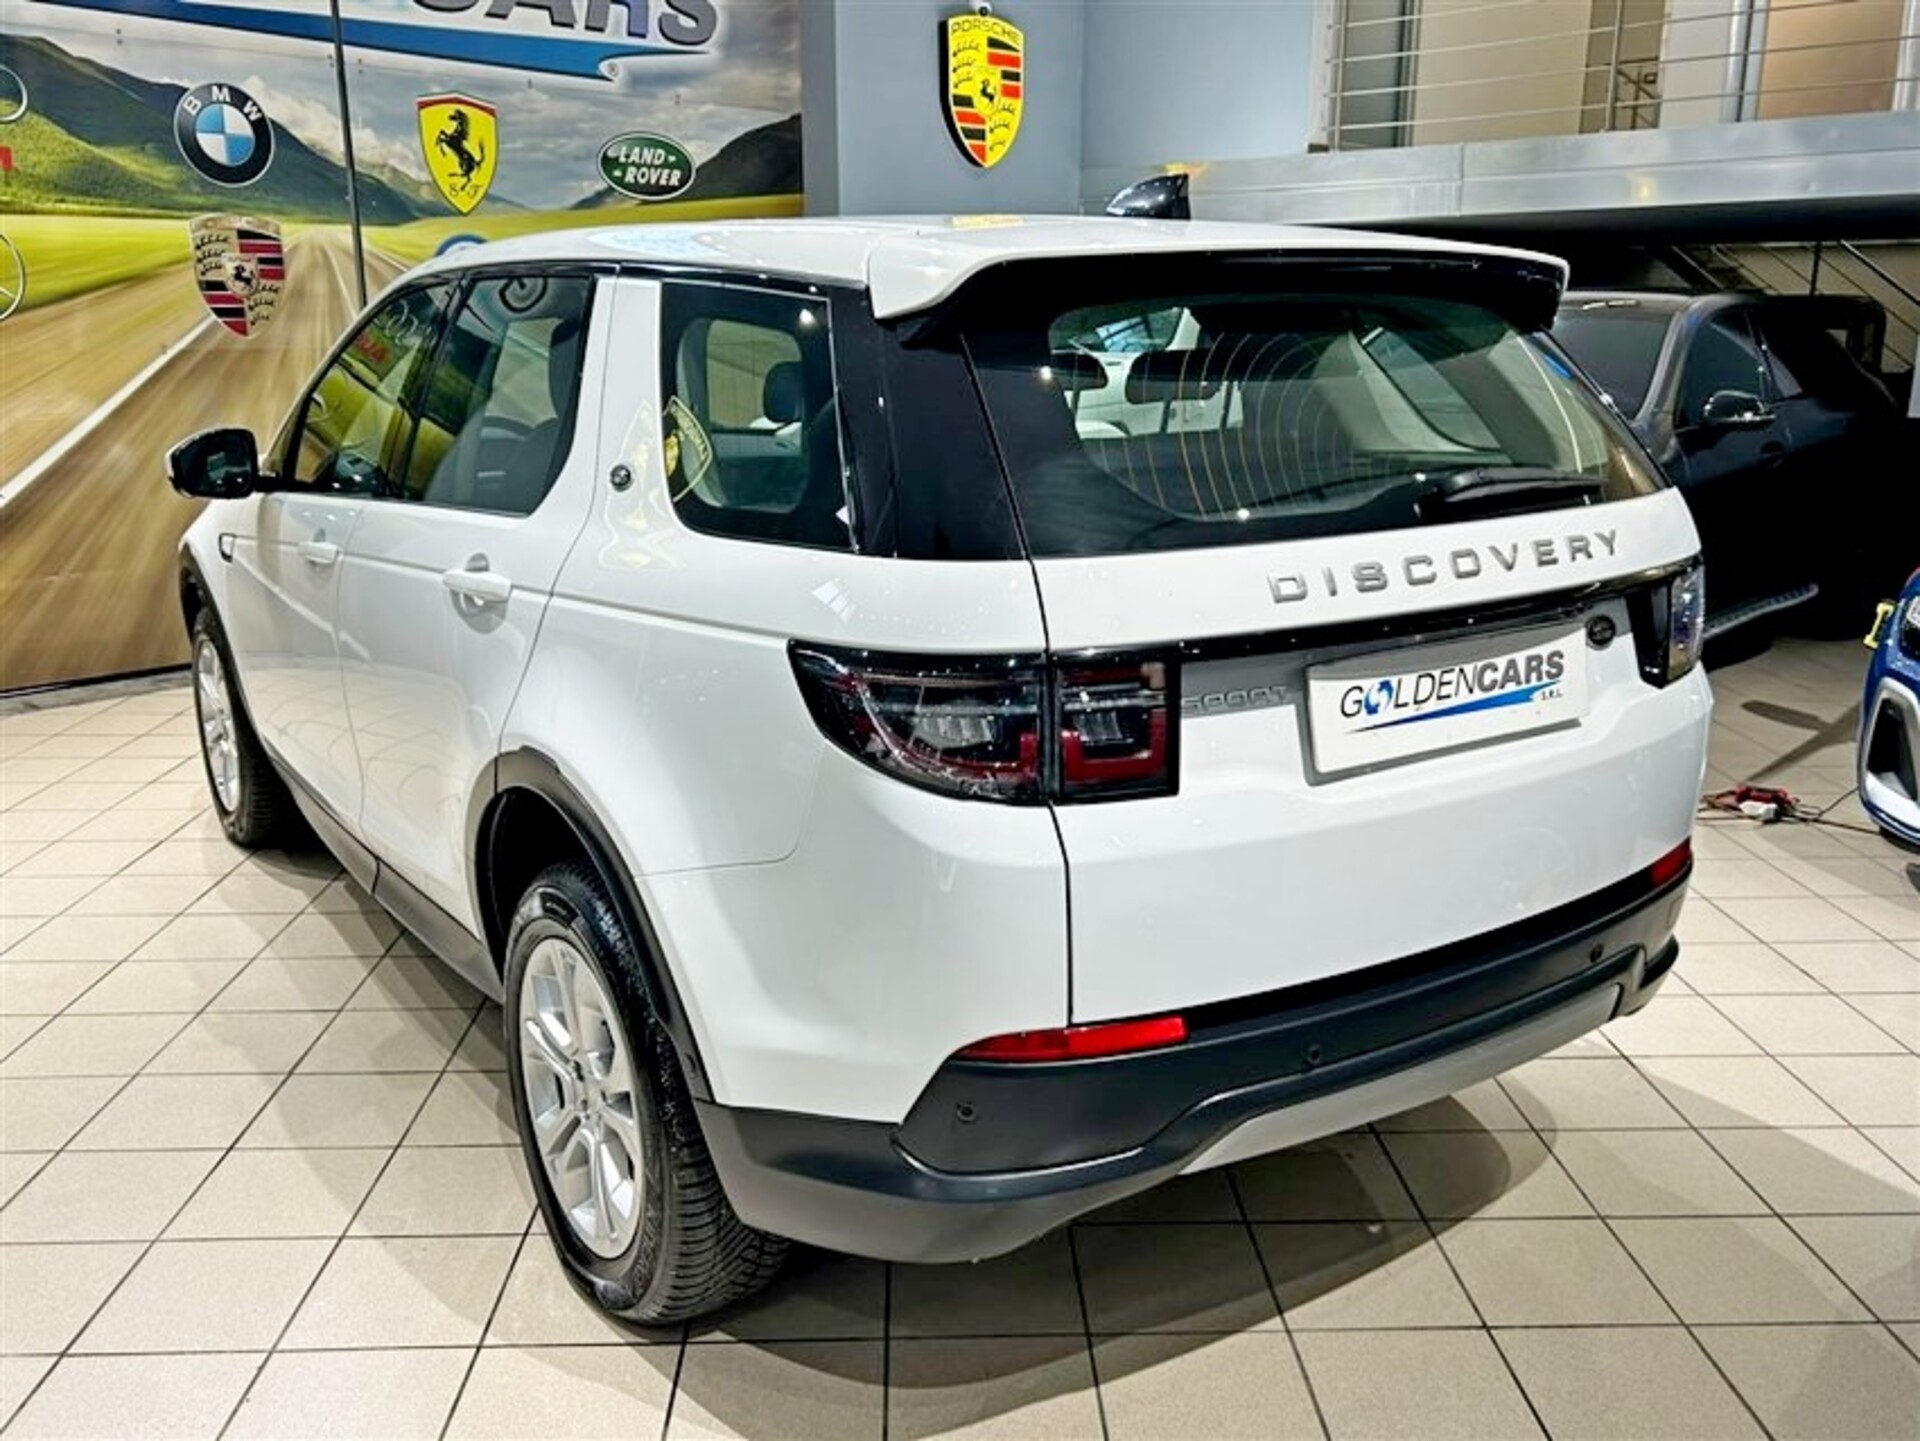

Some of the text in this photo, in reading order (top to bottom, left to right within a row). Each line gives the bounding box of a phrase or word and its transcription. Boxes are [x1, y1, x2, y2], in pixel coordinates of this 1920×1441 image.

[951, 18, 1021, 46] PORSCHE
[183, 85, 263, 122] BMW
[618, 146, 666, 166] LAND
[624, 166, 682, 187] ROVER
[1267, 530, 1617, 604] DISCOVERY
